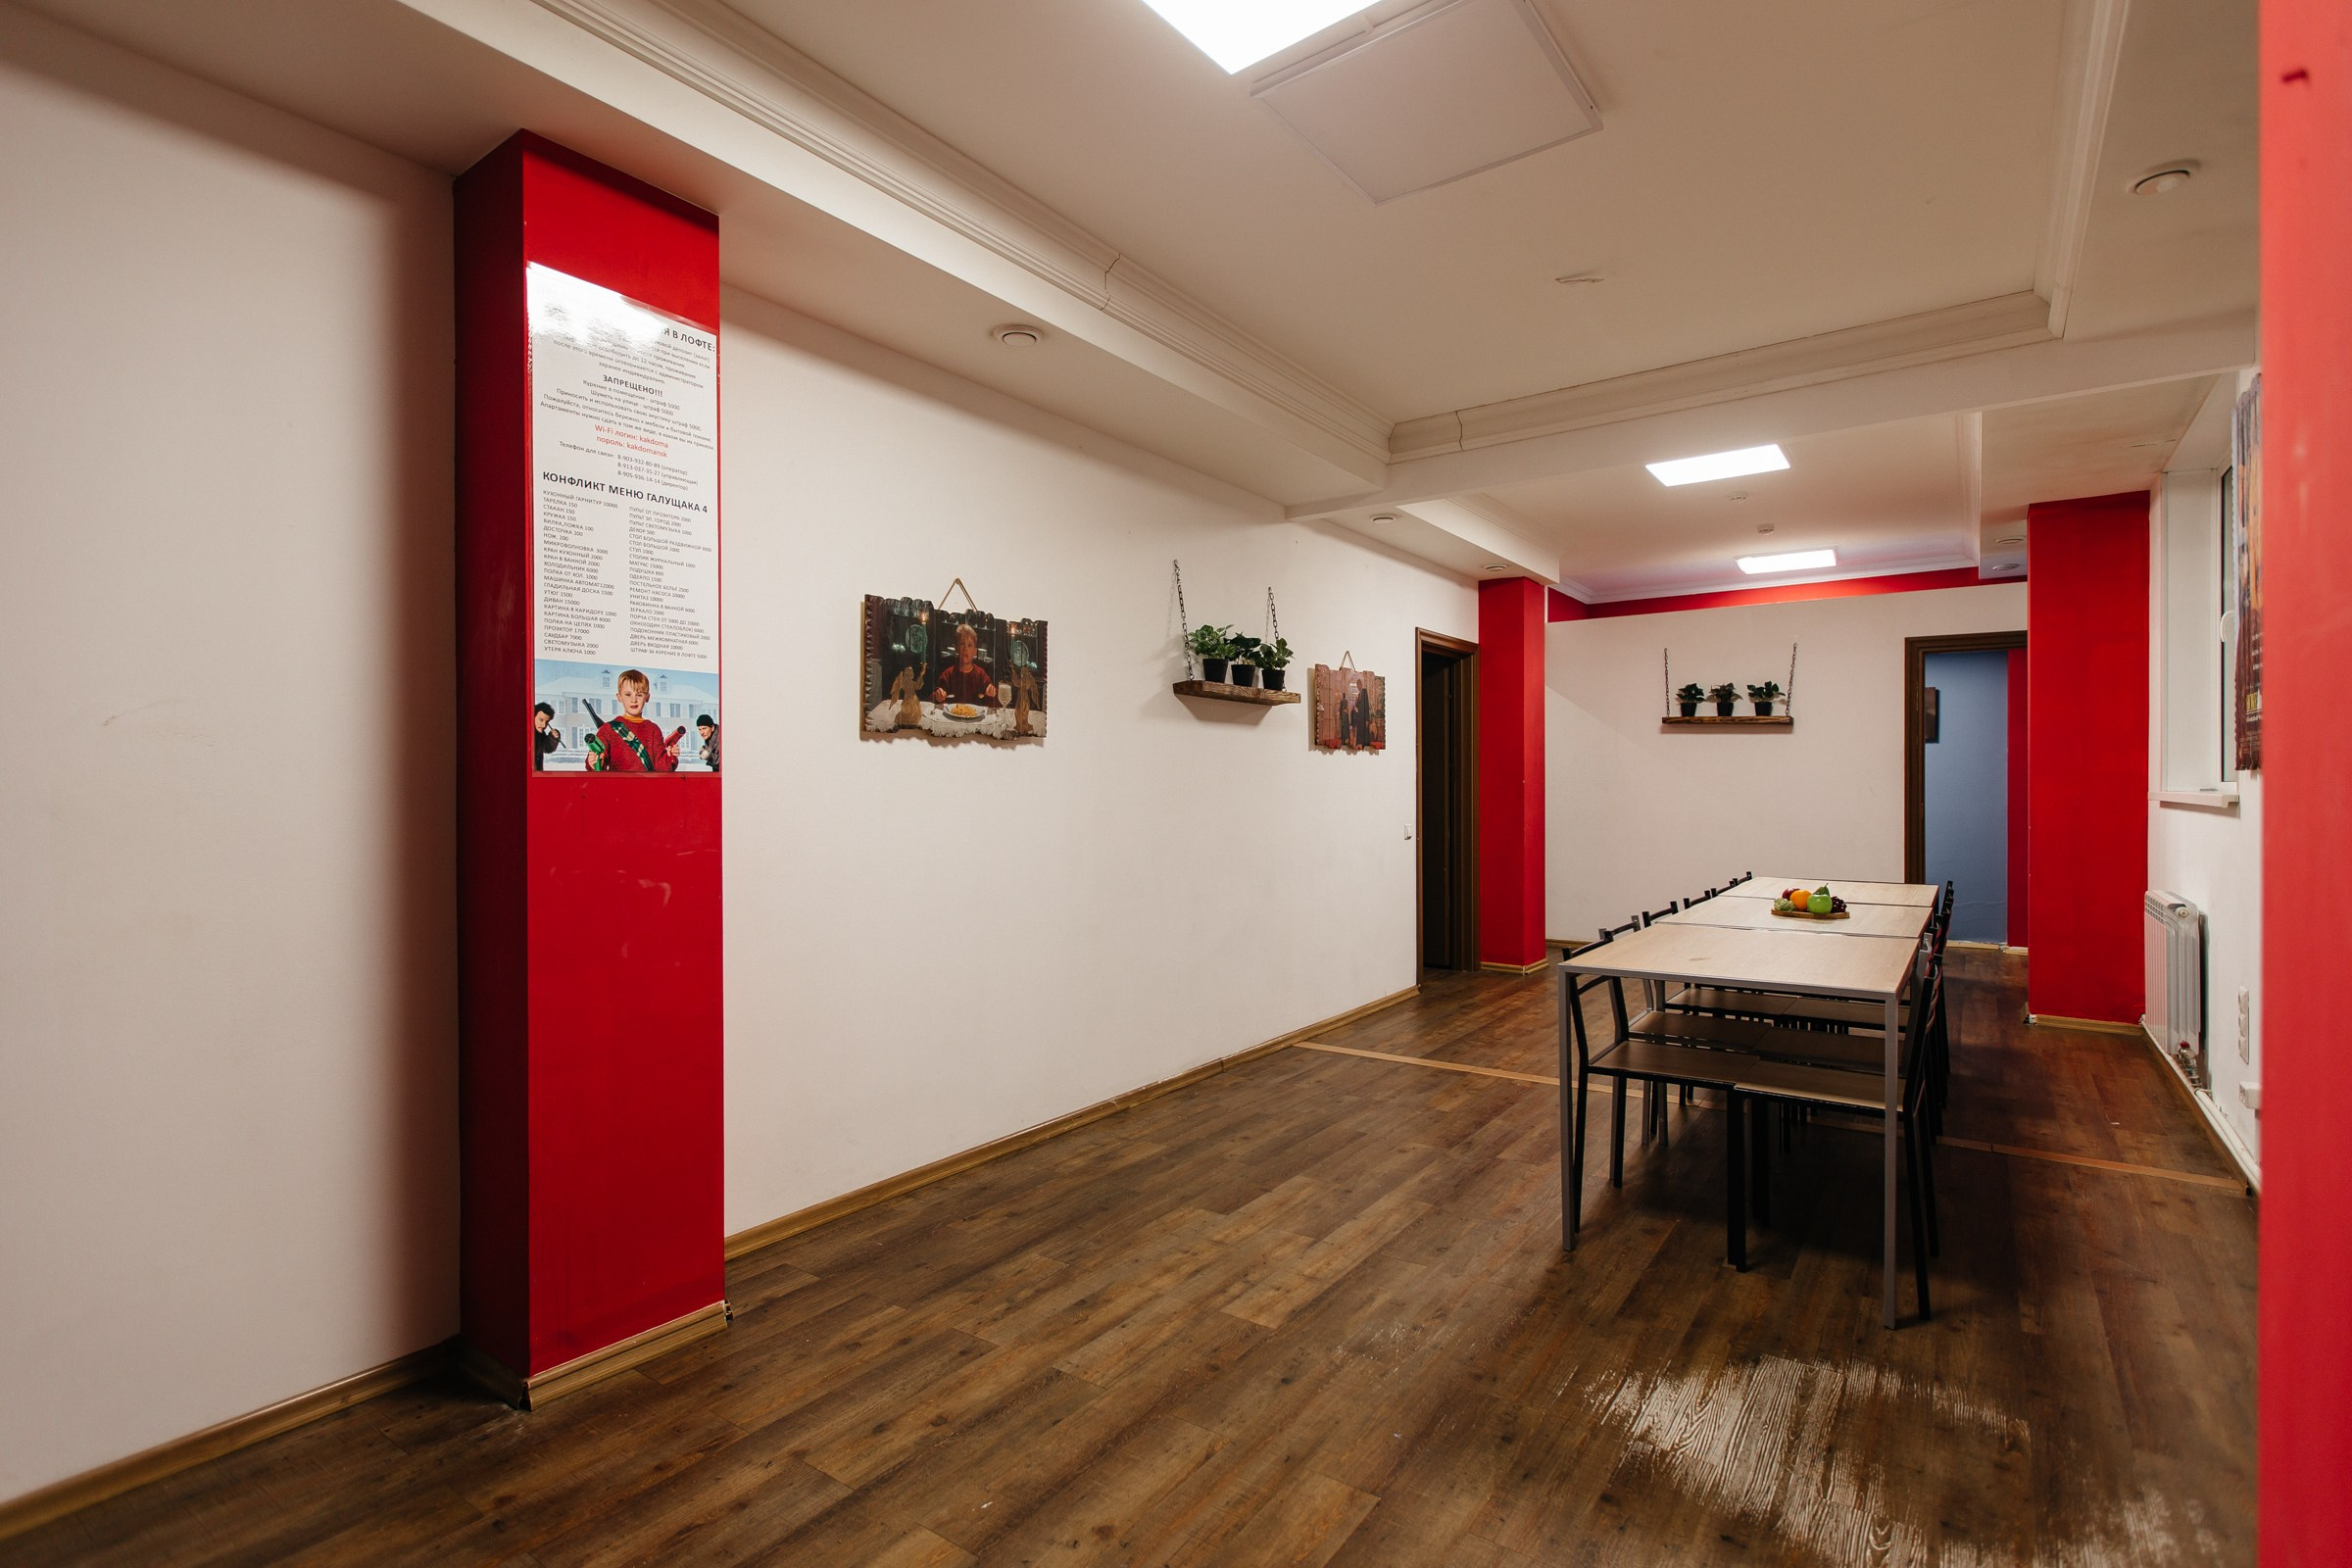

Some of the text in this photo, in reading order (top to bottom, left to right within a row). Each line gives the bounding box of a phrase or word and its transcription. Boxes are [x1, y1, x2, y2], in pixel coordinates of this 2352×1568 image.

[554, 341, 571, 349] после
[673, 331, 679, 339] В
[681, 333, 715, 352] ЛОФТЕ:
[603, 375, 663, 398] ЗАПРЕЩЕНО!!!
[583, 379, 607, 391] Курение
[650, 399, 667, 408] штраф
[557, 388, 588, 401] Приносить
[595, 400, 633, 413] использовать
[590, 389, 613, 400] Шуметь
[622, 399, 639, 407] улице
[643, 405, 660, 414] штраф
[540, 401, 580, 416] Апартаменты
[544, 394, 581, 409] Пожалуйста,
[582, 405, 614, 416] относитесь
[615, 412, 640, 423] бережно
[645, 421, 665, 430] мебели
[670, 427, 691, 437] бытовой
[595, 424, 669, 448] Wi-Fi логин: kakdoma
[559, 441, 584, 451] Телефон
[596, 437, 667, 458] пороль: kakdomansk
[543, 471, 708, 513] КОНФЛИКТ МЕНЮ ГАЛУЩАКА 4
[543, 490, 574, 500] КУХОННЫЙ
[576, 496, 602, 505] ГАРНИТУР
[543, 497, 567, 506] ТАРЕЛКА
[543, 504, 564, 512] СТАКАН
[543, 511, 566, 519] КРУЖКА
[543, 525, 573, 535] ДОСТОЧКА
[544, 540, 594, 552] МИКРОВОЛНОВКА
[643, 542, 668, 551] БОЛЬШОЙ
[559, 549, 590, 558] КУХОННЫЙ
[544, 561, 585, 571] ХОЛОДИЛЬНИК
[629, 567, 654, 575] ПОДУШКА
[544, 575, 574, 584] МАШИНКА
[544, 582, 581, 592] ГЛАДИЛЬНАЯ
[544, 639, 585, 647] СВЕТОМУЗЫКА
